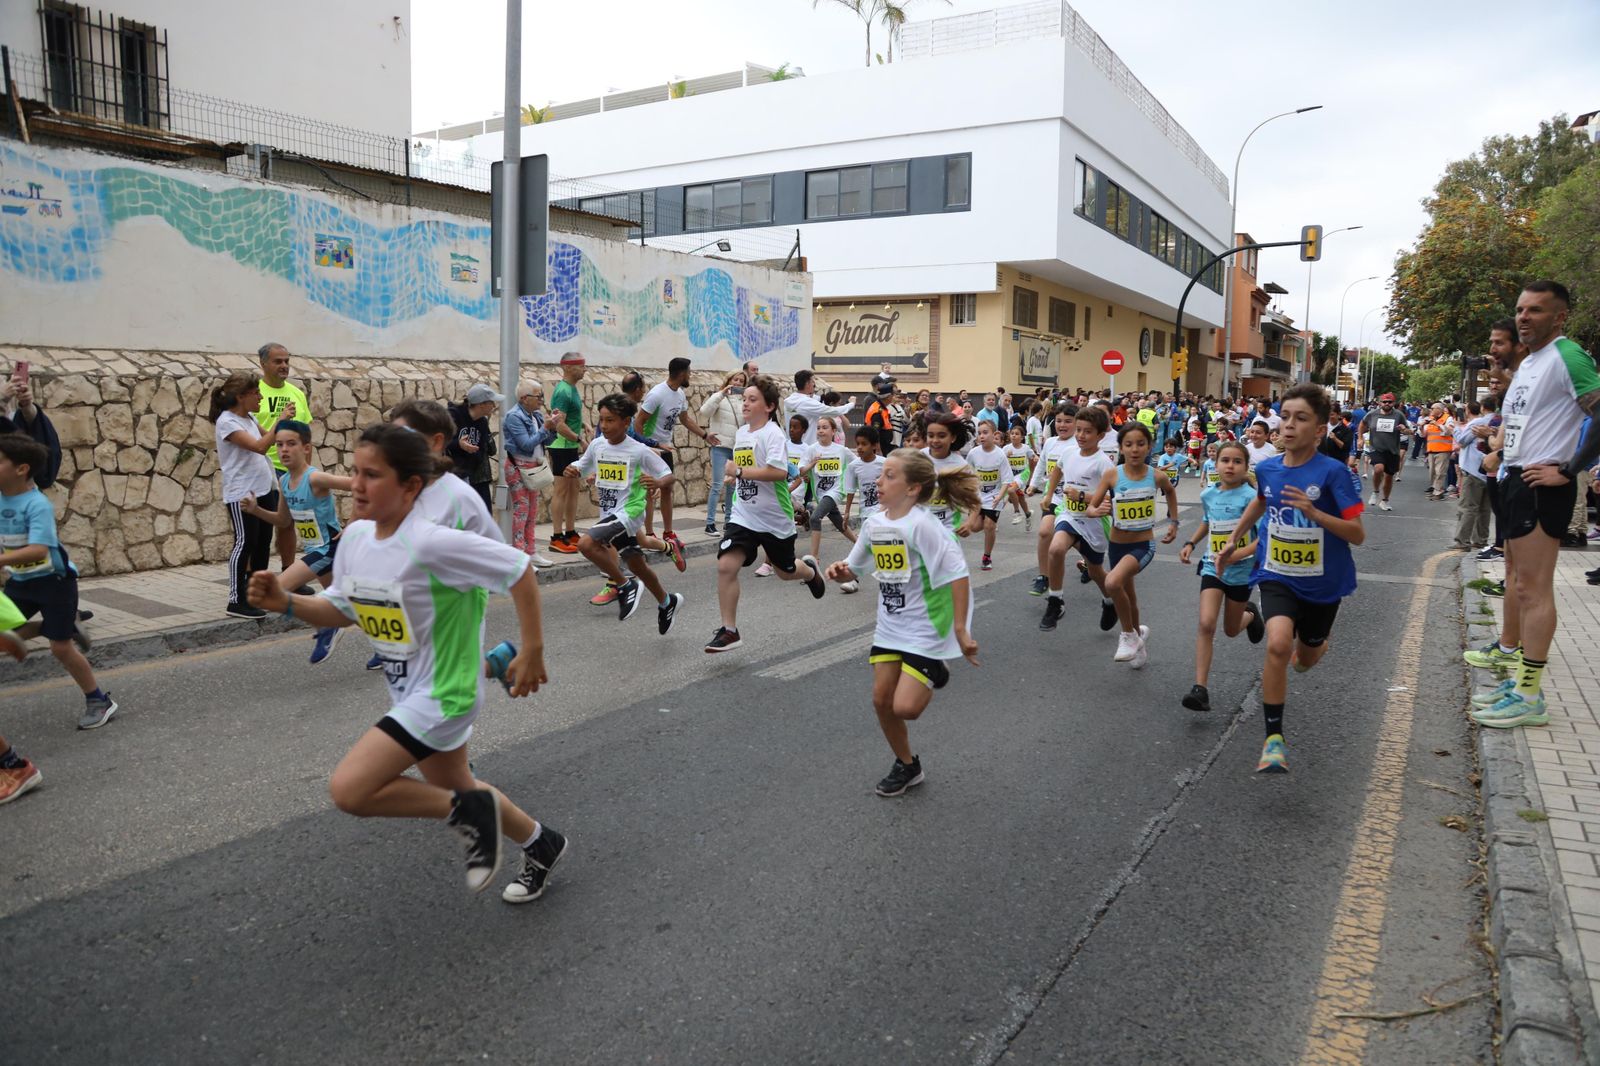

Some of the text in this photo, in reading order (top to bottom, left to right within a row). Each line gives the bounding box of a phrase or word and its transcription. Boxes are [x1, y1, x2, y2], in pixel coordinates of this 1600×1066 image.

[824, 311, 900, 354] Grand
[1029, 346, 1051, 374] Grand
[268, 397, 278, 412] V
[600, 469, 624, 480] 1041
[819, 463, 839, 471] 1060
[1120, 505, 1153, 519] 1016
[1273, 547, 1316, 564] 1034
